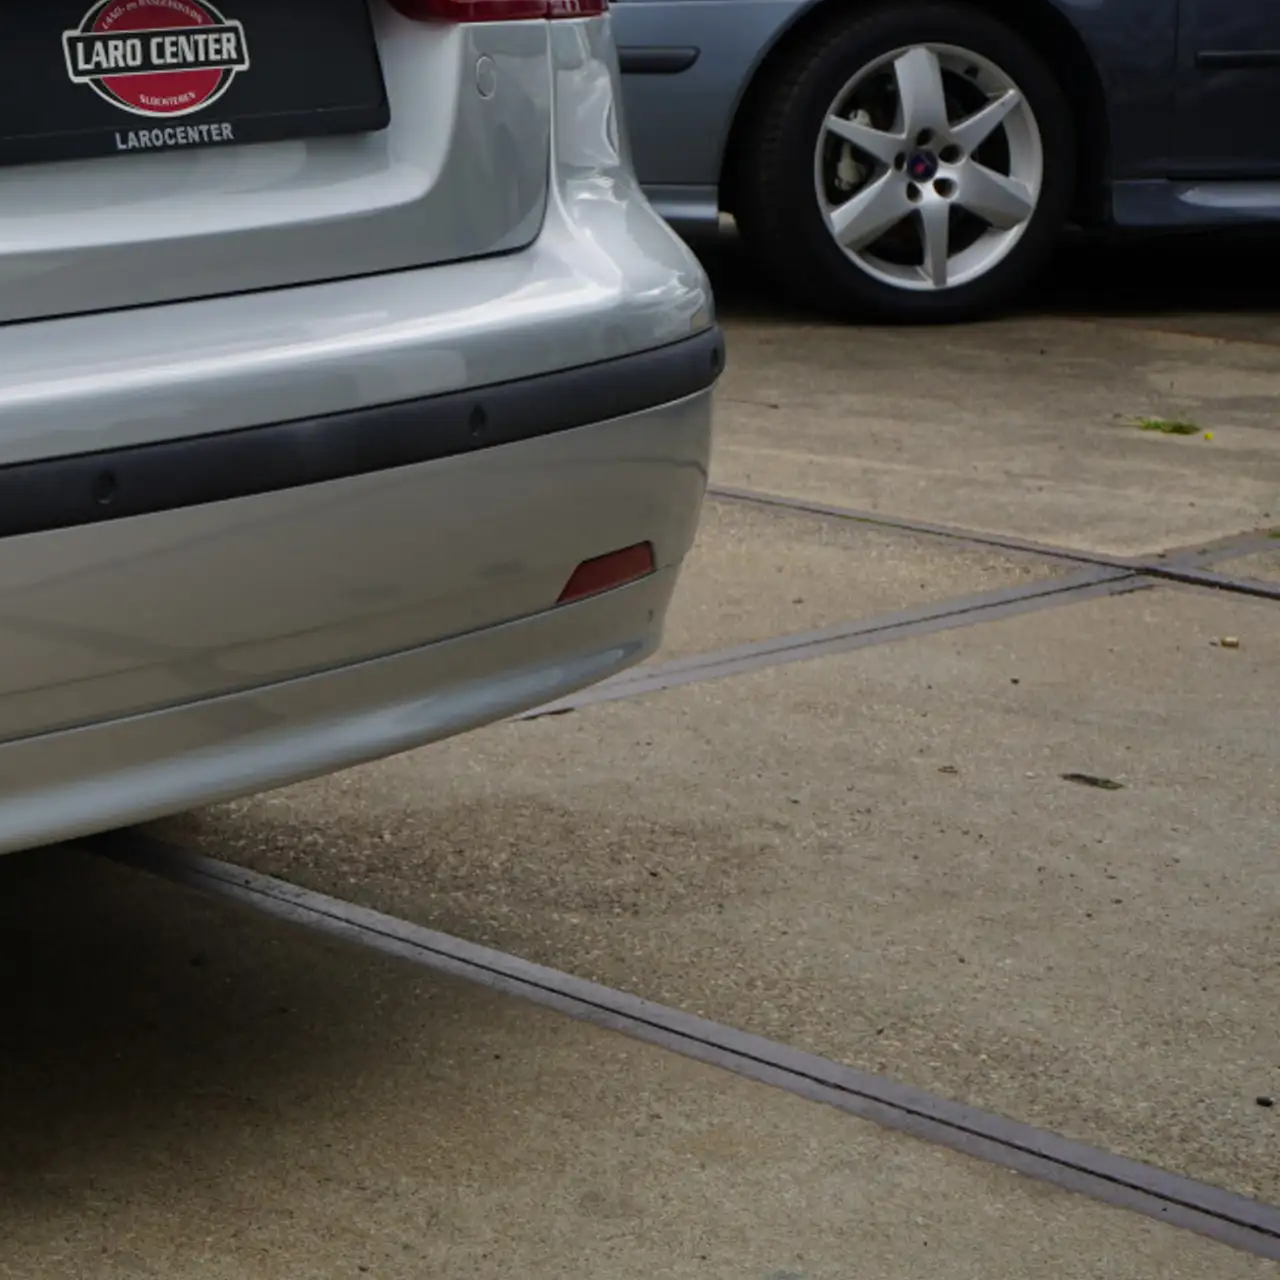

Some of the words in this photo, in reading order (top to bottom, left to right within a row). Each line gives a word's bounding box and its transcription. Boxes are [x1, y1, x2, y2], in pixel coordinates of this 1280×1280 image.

[76, 38, 141, 70] LARO
[149, 31, 238, 65] CENTER
[115, 122, 235, 150] LAROCENTER
